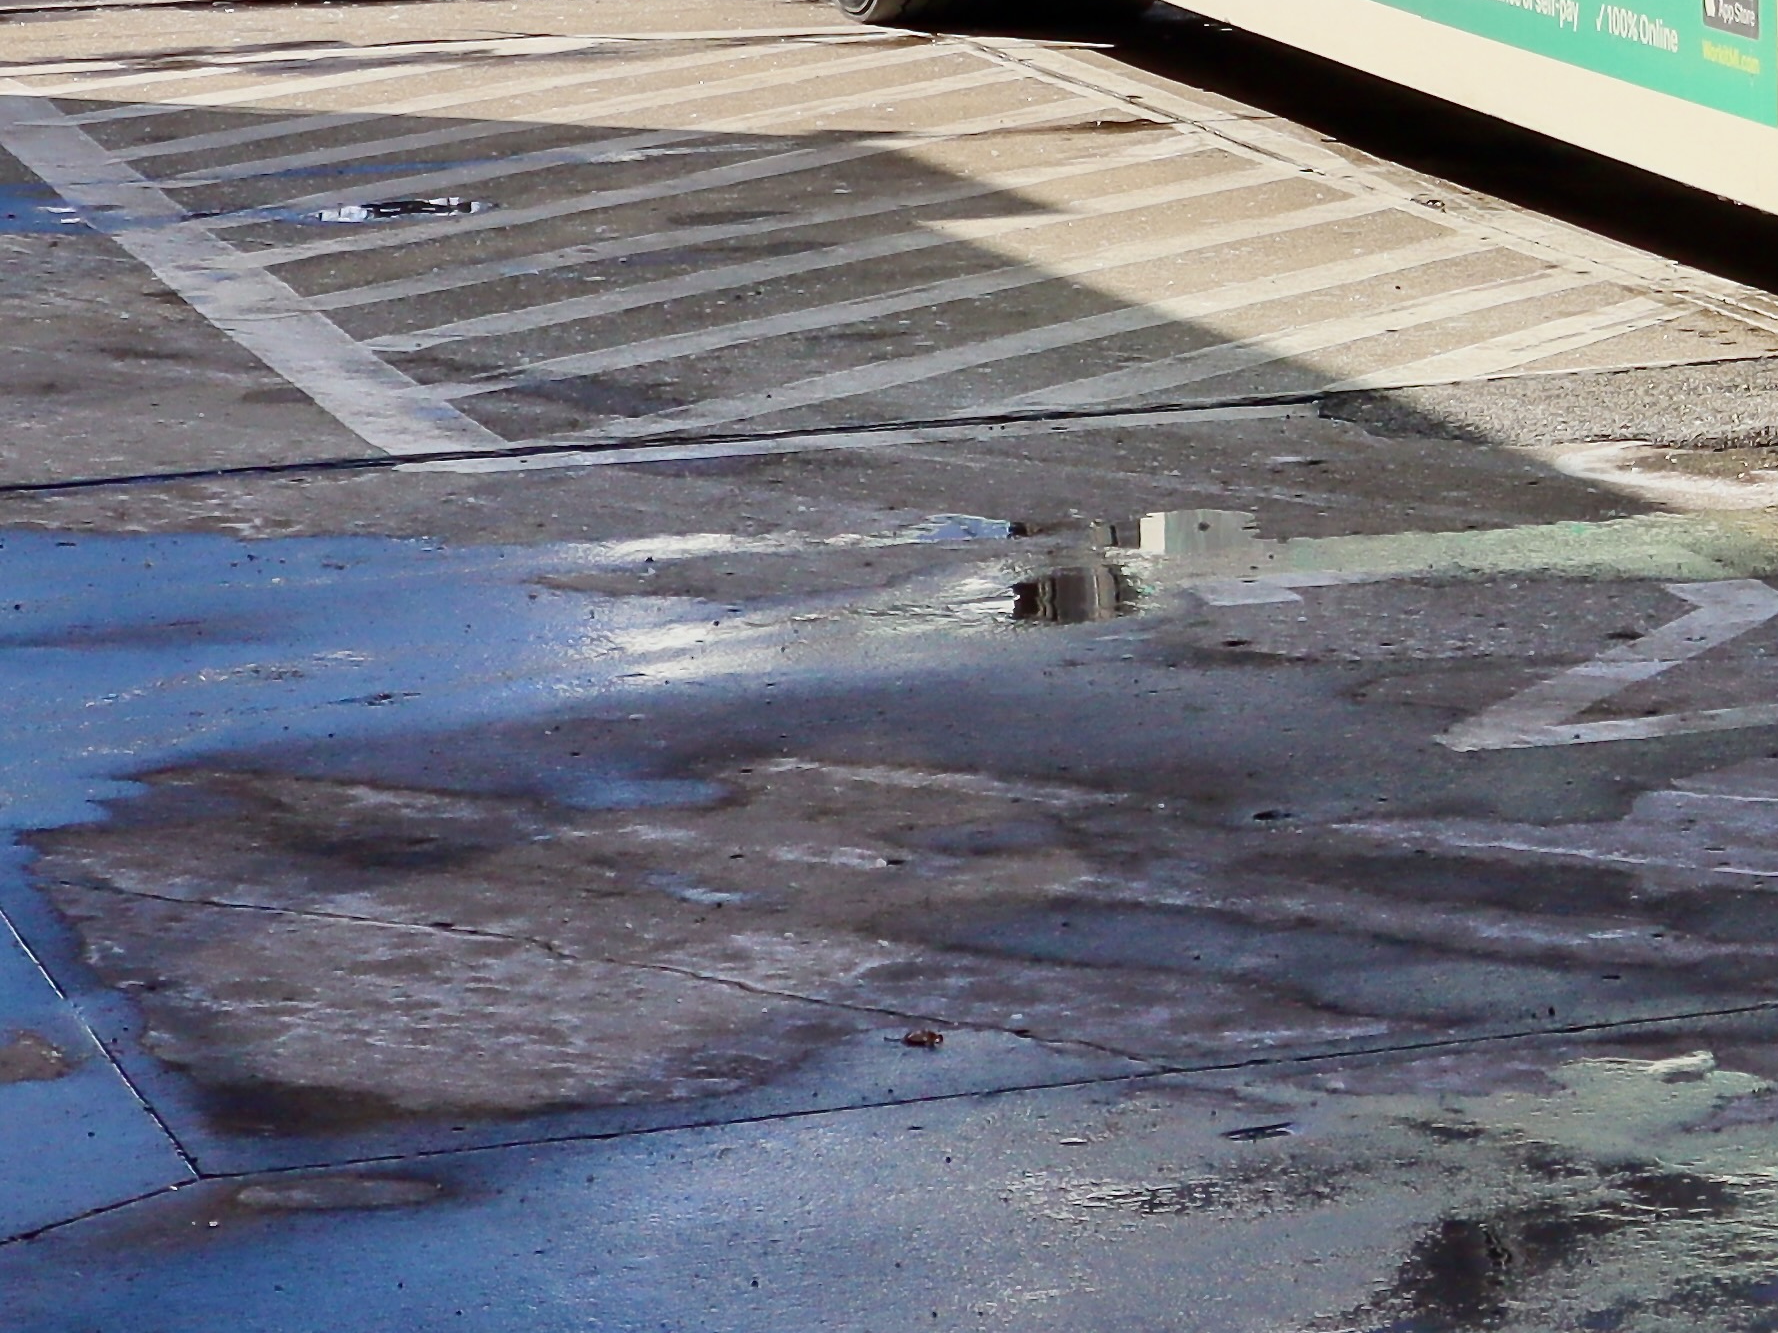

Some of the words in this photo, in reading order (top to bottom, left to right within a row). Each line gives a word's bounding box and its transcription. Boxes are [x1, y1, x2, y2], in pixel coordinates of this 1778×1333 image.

[1607, 4, 1638, 42] 100%
[1639, 14, 1678, 53] Online
[1734, 1, 1756, 27] Store
